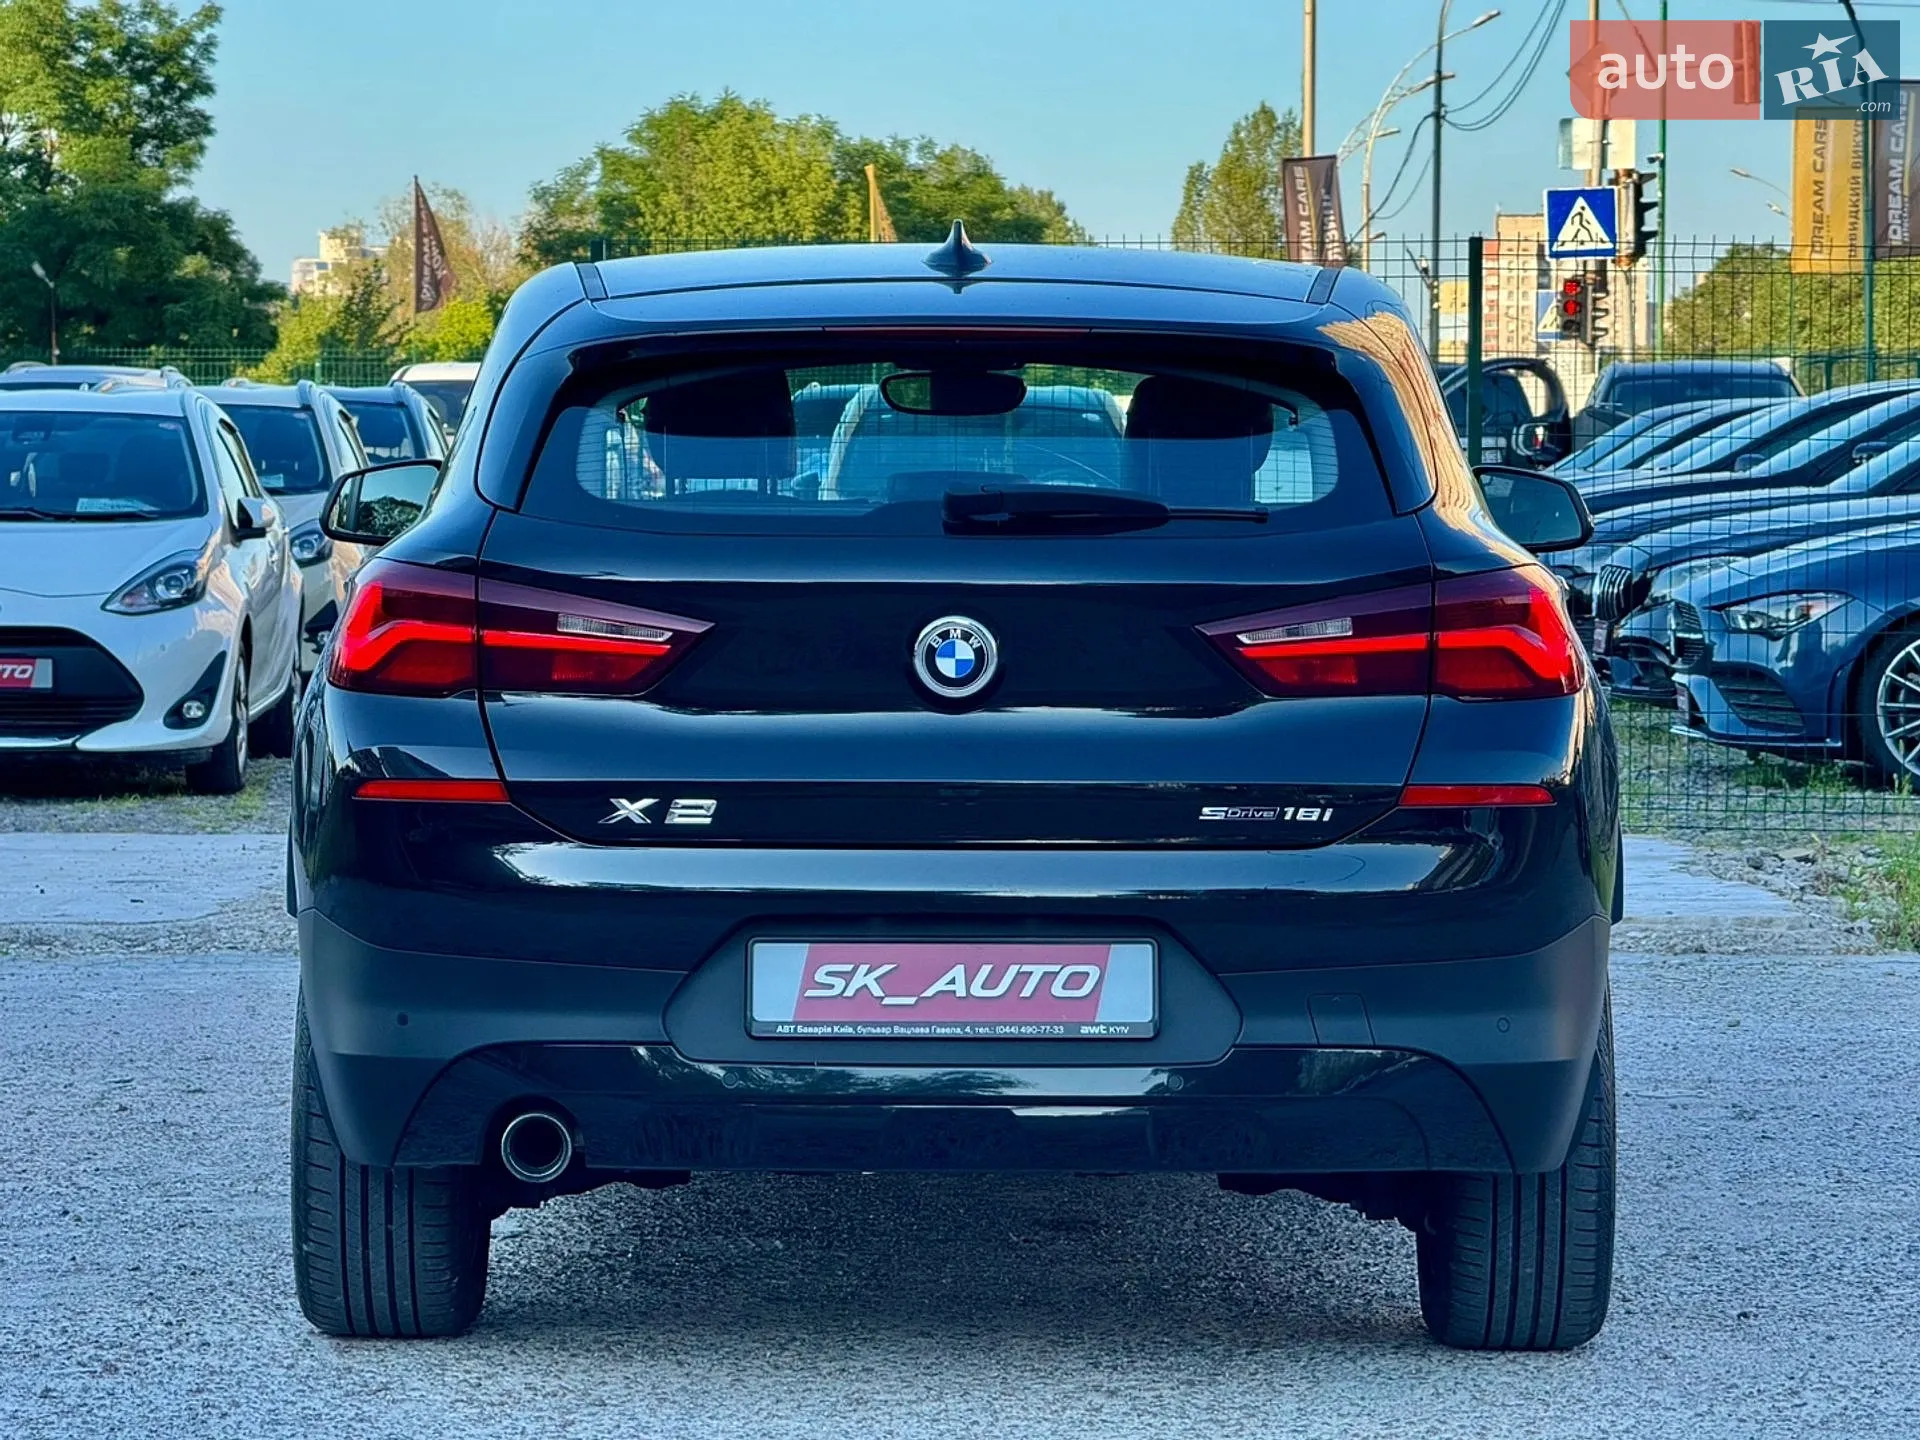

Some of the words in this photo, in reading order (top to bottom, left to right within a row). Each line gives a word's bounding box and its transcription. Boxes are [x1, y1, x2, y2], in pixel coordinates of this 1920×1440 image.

[1812, 117, 1828, 173] CARS
[1810, 179, 1825, 255] DREAM
[1887, 158, 1905, 245] DREAM
[929, 628, 982, 649] BMW
[803, 964, 1101, 1005] SK_AUTO
